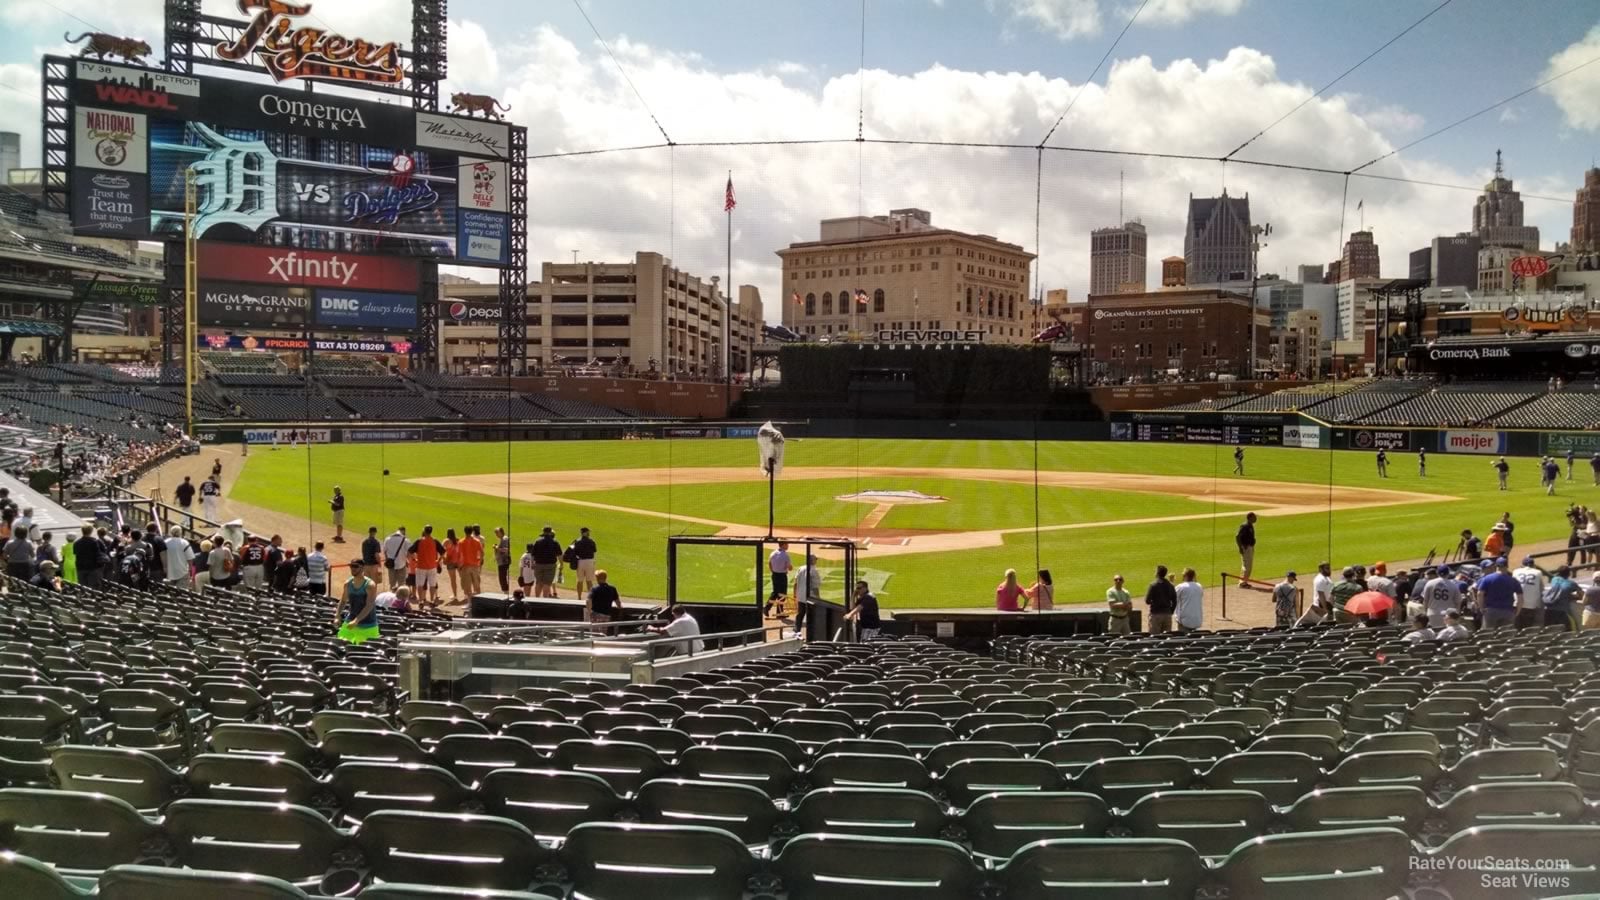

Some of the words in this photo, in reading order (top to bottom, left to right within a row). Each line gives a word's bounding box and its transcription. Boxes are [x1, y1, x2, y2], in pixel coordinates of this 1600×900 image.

[215, 0, 401, 74] Tigers
[81, 63, 94, 71] TV
[155, 74, 198, 86] DETROIT
[290, 116, 339, 131] PARK
[93, 188, 114, 198] Trust
[116, 190, 130, 199] the
[88, 196, 133, 214] Team
[344, 179, 438, 225] Dodgers
[90, 212, 107, 221] that
[109, 214, 132, 222] treats
[464, 212, 503, 223] Confidence
[99, 221, 124, 230] yours
[464, 220, 487, 229] comes
[488, 222, 503, 230] with
[464, 228, 483, 236] every
[268, 252, 358, 284] xfinity
[1513, 257, 1547, 273] AAA
[130, 284, 158, 296] Green
[205, 292, 242, 304] MGM
[260, 295, 308, 308] GRAND
[321, 297, 359, 311] DMC
[361, 302, 391, 315] always
[225, 304, 289, 314] DETROIT
[469, 307, 502, 319] pepsi
[1525, 309, 1565, 322] JUNGLE
[880, 330, 987, 342] CHEVROLET
[265, 339, 309, 348] #PICKRICK
[315, 341, 335, 349] TEXT
[336, 342, 347, 350] A3
[348, 342, 359, 350] TO
[360, 343, 385, 351] 89269
[1482, 347, 1511, 357] Bank
[1302, 432, 1319, 440] VISION
[1375, 432, 1403, 440] JIMMY
[1450, 434, 1493, 450] meijer
[249, 551, 261, 560] 35
[1519, 573, 1536, 585] 32
[1433, 588, 1449, 600] 66
